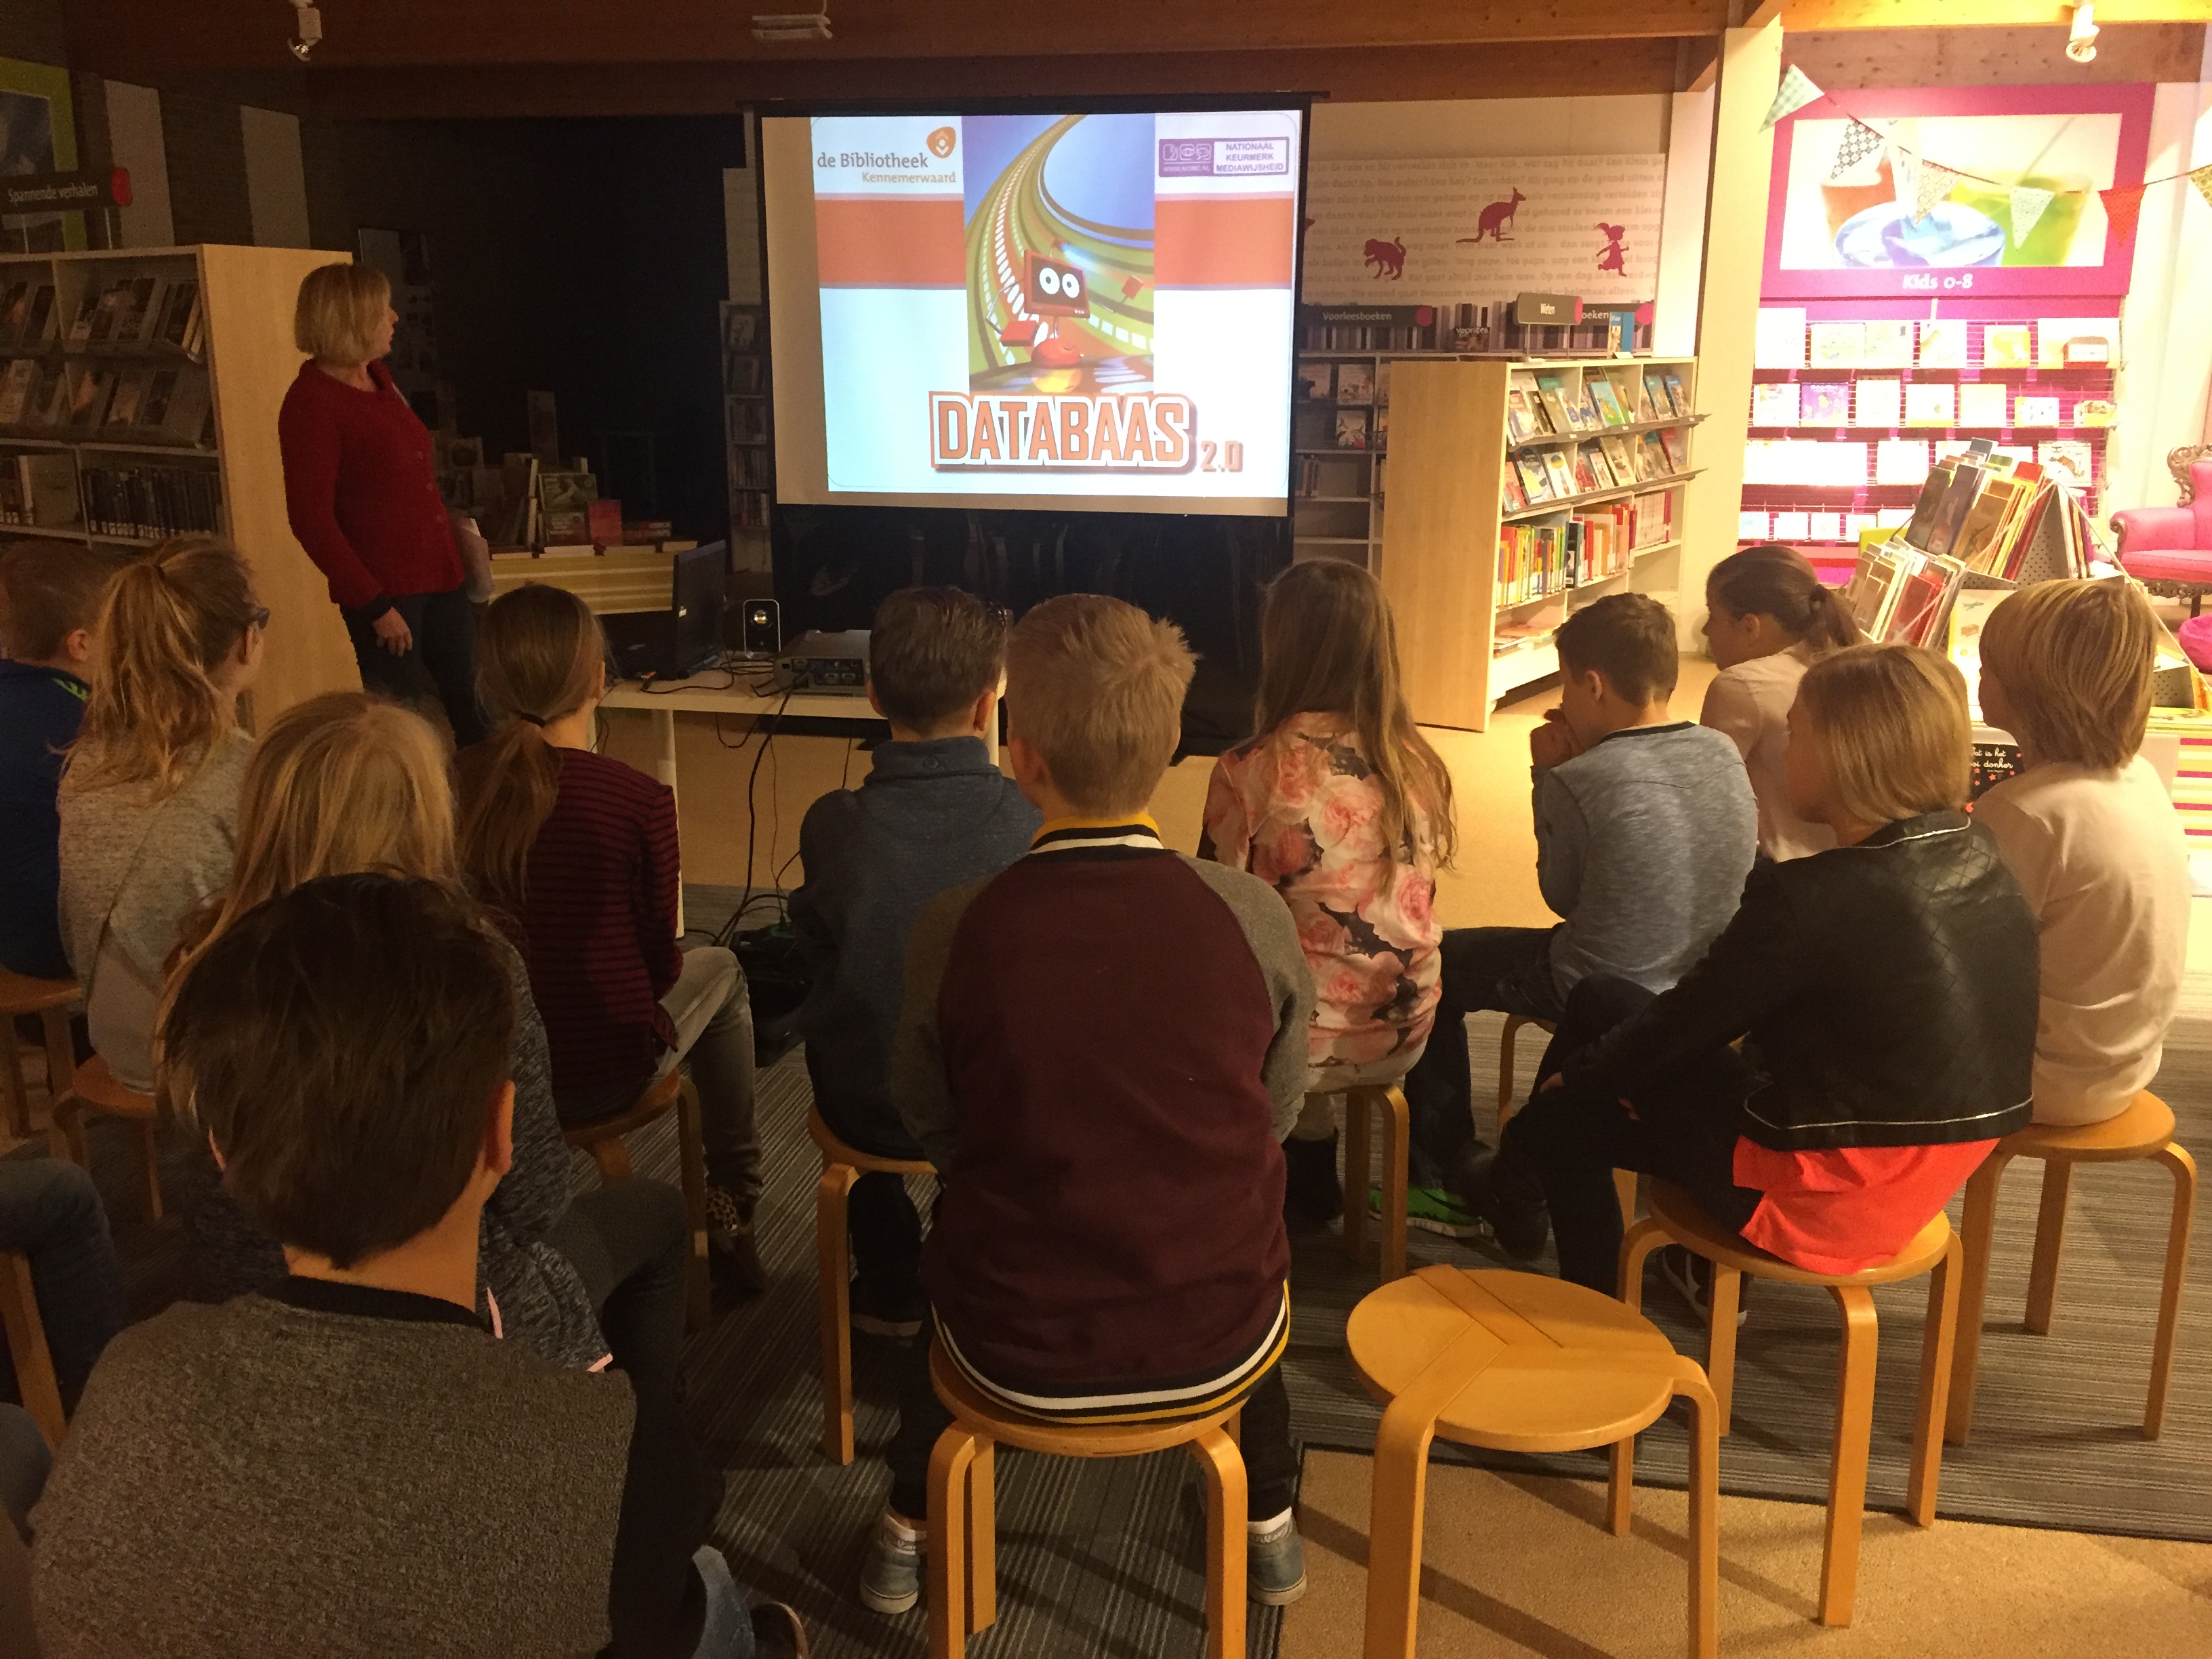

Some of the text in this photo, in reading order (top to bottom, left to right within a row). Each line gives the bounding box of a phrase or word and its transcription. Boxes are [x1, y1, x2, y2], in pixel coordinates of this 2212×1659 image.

[1226, 142, 1274, 151] NATIONAAL
[817, 152, 928, 167] de Bibliotheek
[1226, 152, 1274, 161] KEURMERK
[1216, 163, 1284, 173] MEDIAWIJSHEID
[862, 171, 956, 184] Kennemerwaard
[8, 182, 98, 206] Spannende verhalen
[1903, 273, 1938, 289] Kids
[1540, 303, 1555, 315] Weten
[1322, 310, 1392, 321] Voorleesboeken
[934, 396, 1244, 473] DATABAAS 2.0
[1983, 758, 2013, 769] donker
